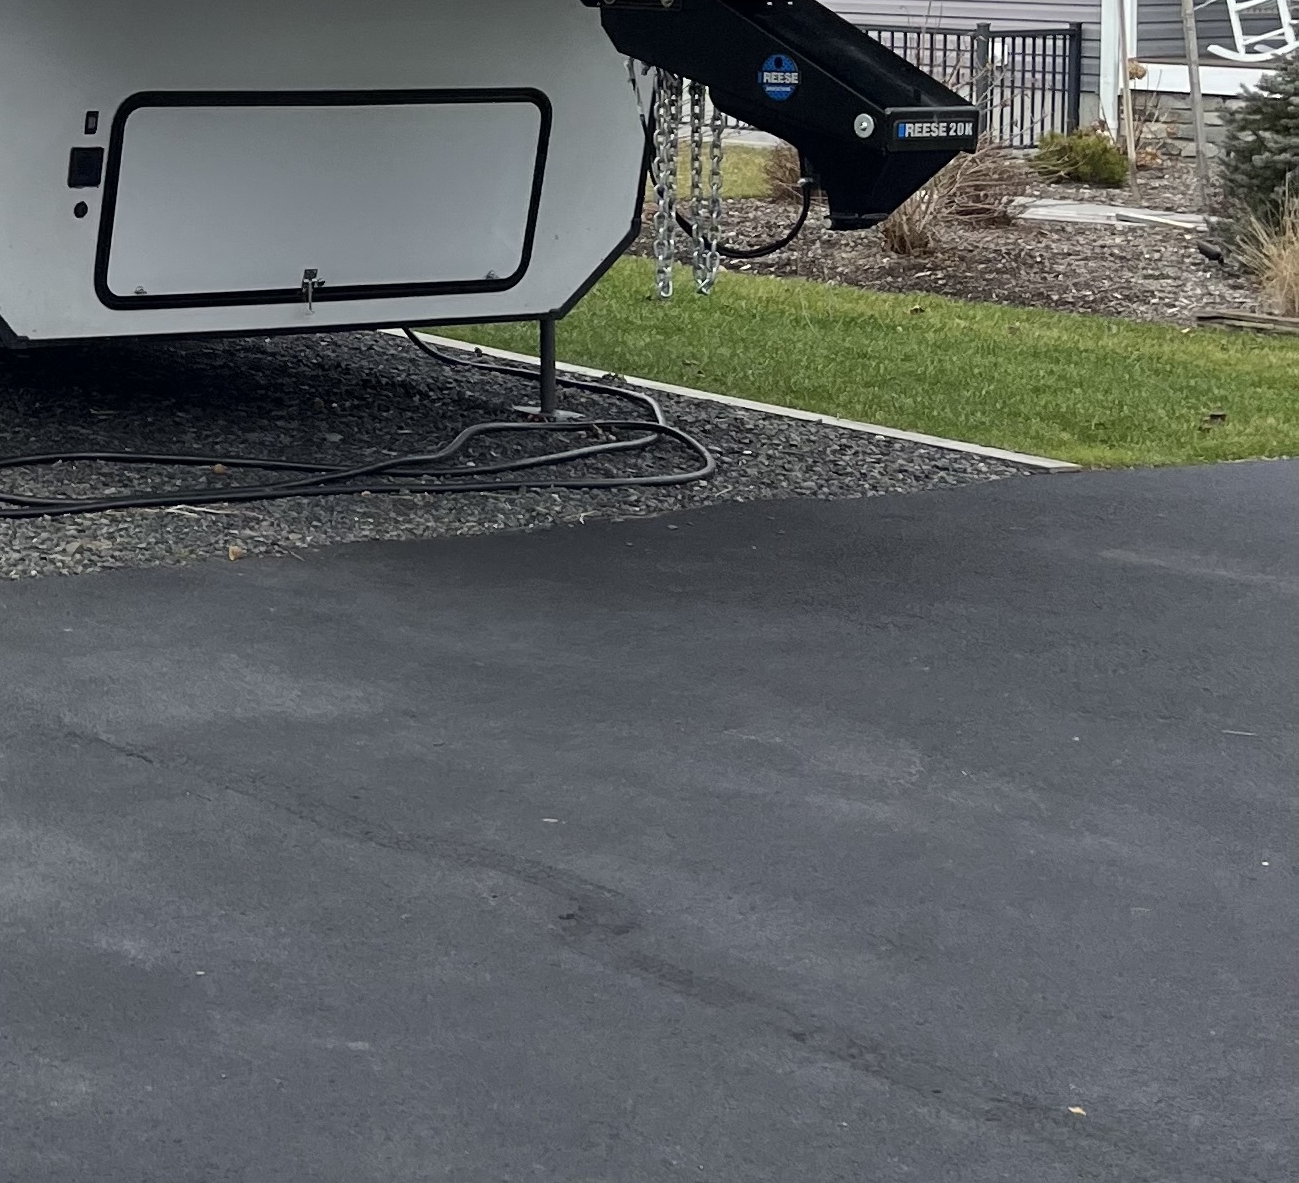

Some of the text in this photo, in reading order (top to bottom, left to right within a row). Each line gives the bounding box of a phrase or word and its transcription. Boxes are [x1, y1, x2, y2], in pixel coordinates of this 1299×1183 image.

[763, 71, 799, 84] REESE
[904, 122, 973, 138] REESE 20K
